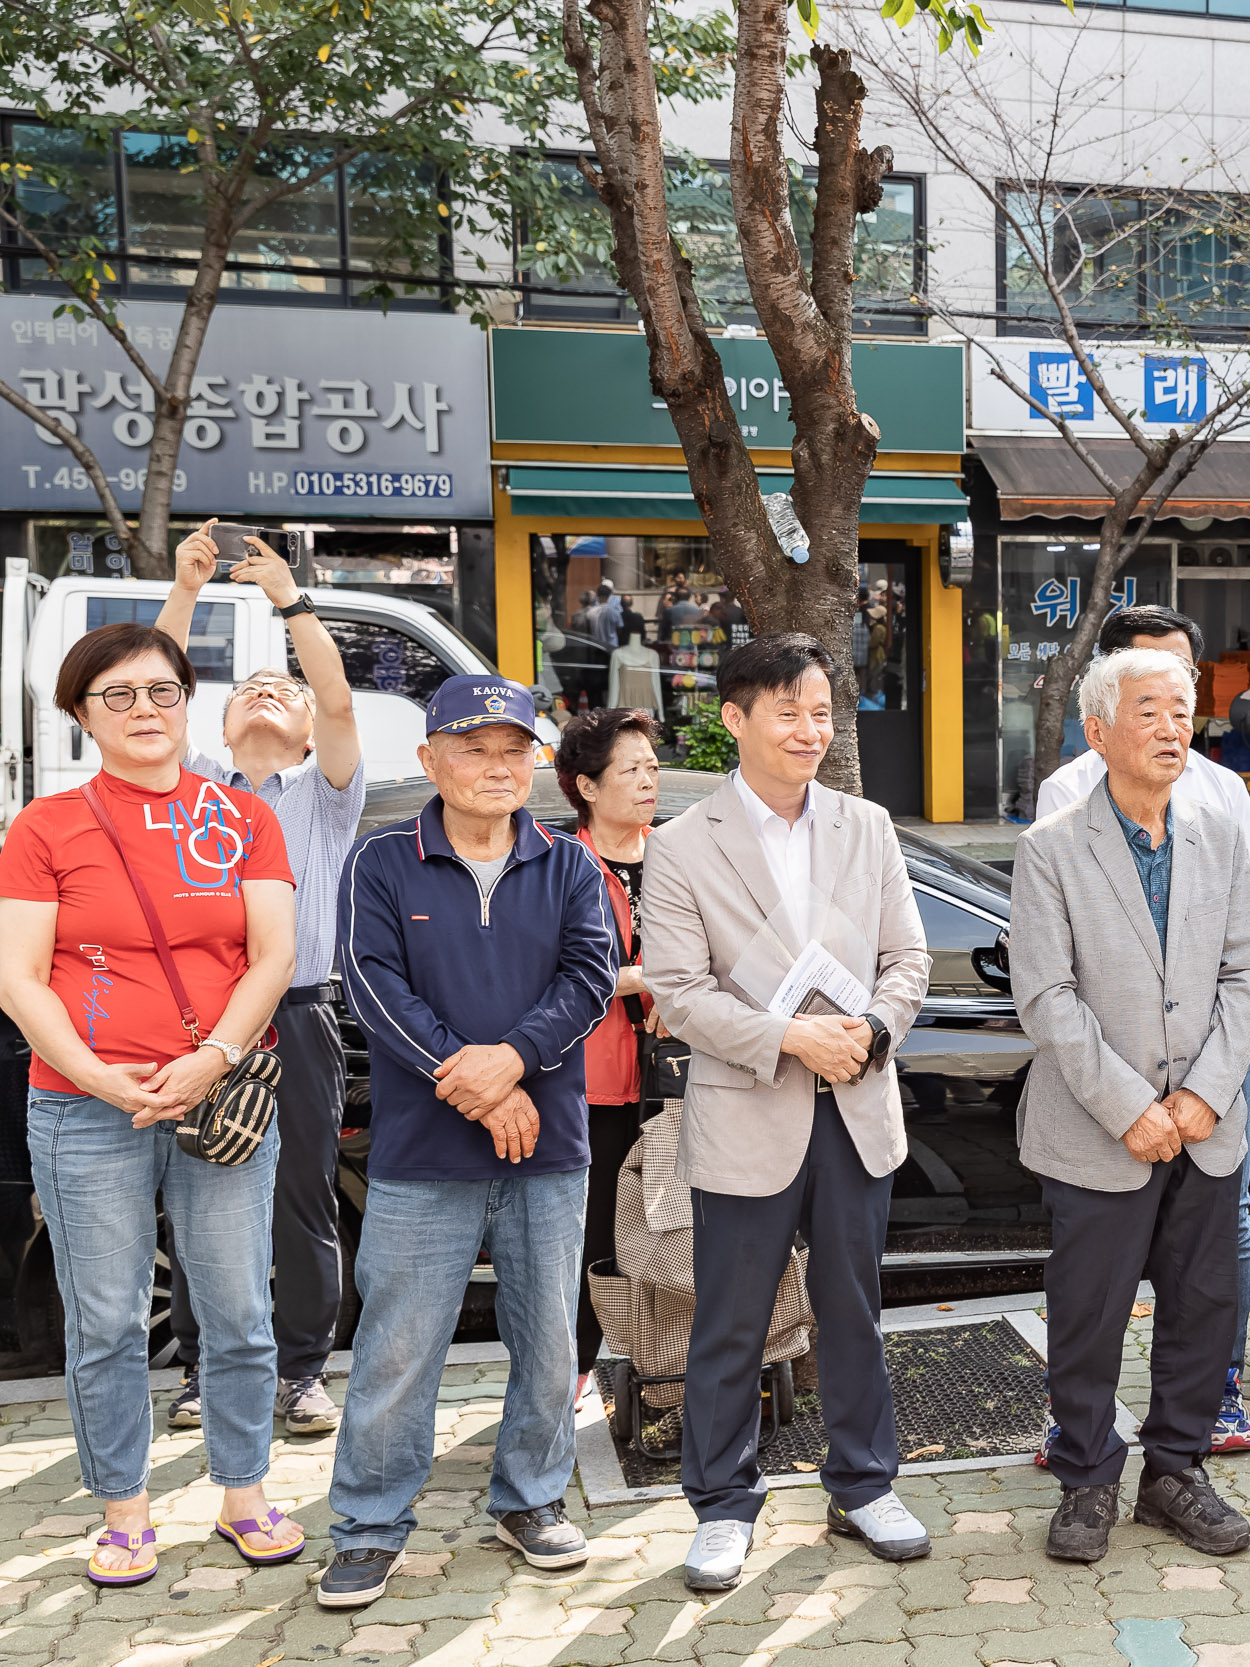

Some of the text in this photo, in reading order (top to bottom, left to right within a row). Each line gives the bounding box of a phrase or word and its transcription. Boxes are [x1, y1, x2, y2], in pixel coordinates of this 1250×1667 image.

[11, 319, 98, 347] 인테리어
[18, 366, 450, 453] 광성종합공사
[1007, 641, 1032, 661] 모든
[473, 686, 515, 698] KAOVA
